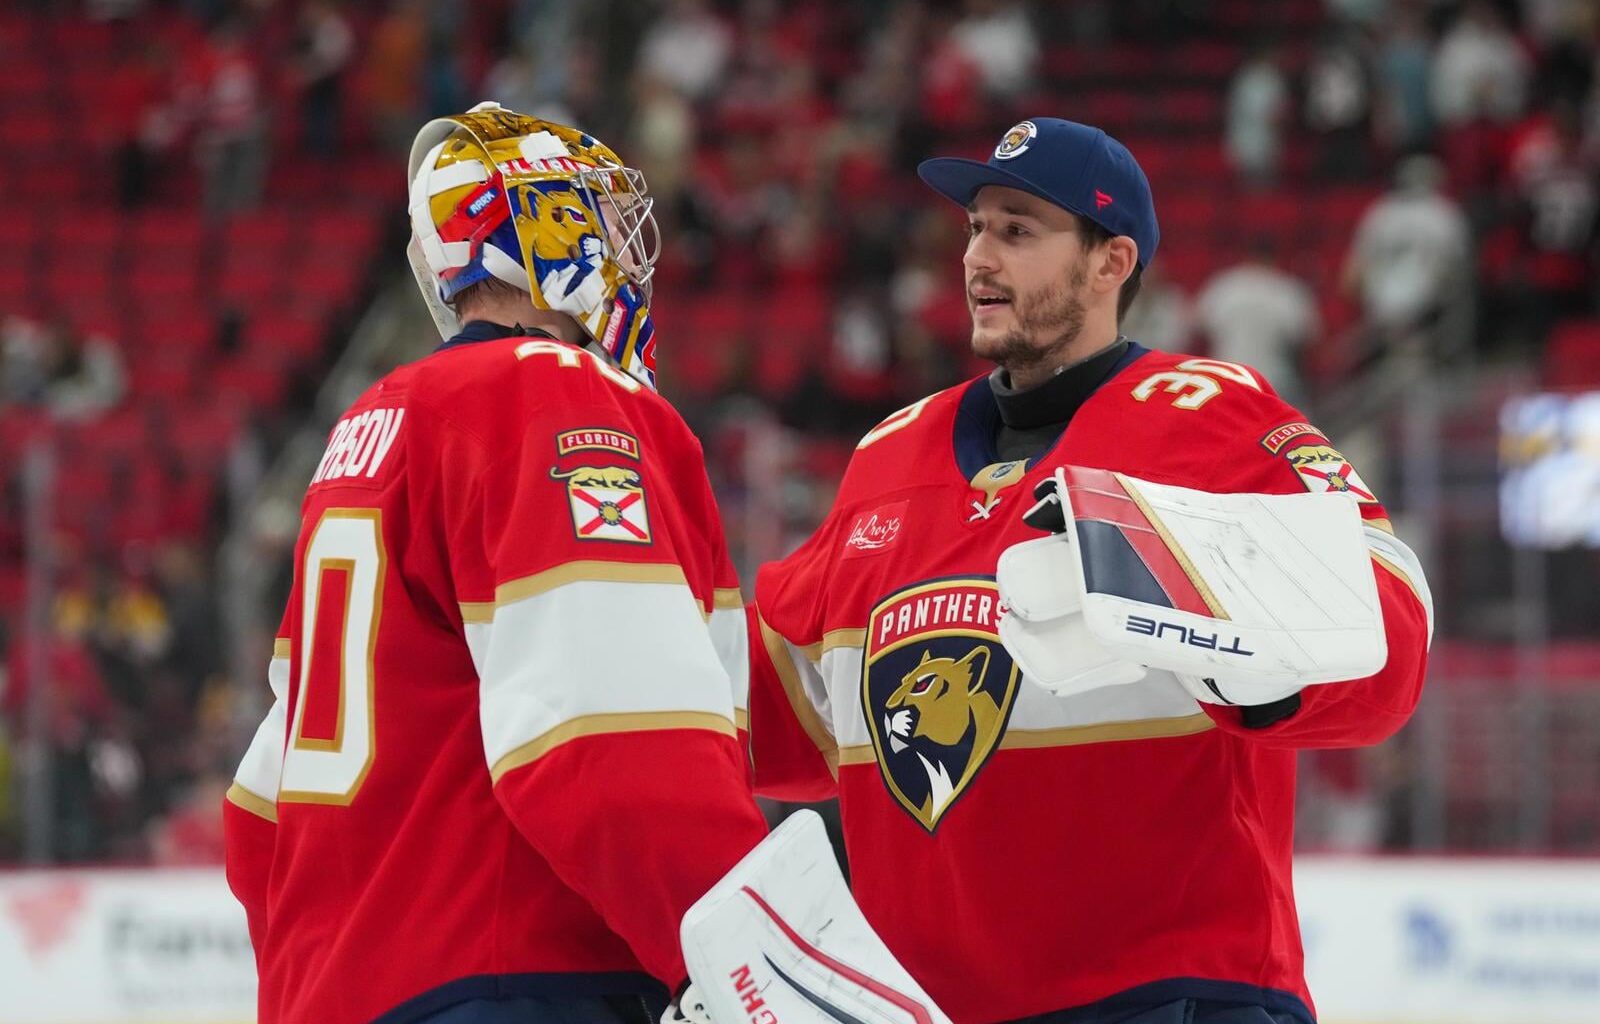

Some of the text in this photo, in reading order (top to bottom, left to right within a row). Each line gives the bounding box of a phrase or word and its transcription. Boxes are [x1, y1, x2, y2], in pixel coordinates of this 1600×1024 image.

[1131, 358, 1263, 411] 30
[309, 408, 405, 486] RASOV
[567, 433, 630, 450] FLORIDA
[1126, 614, 1255, 656] TRUE
